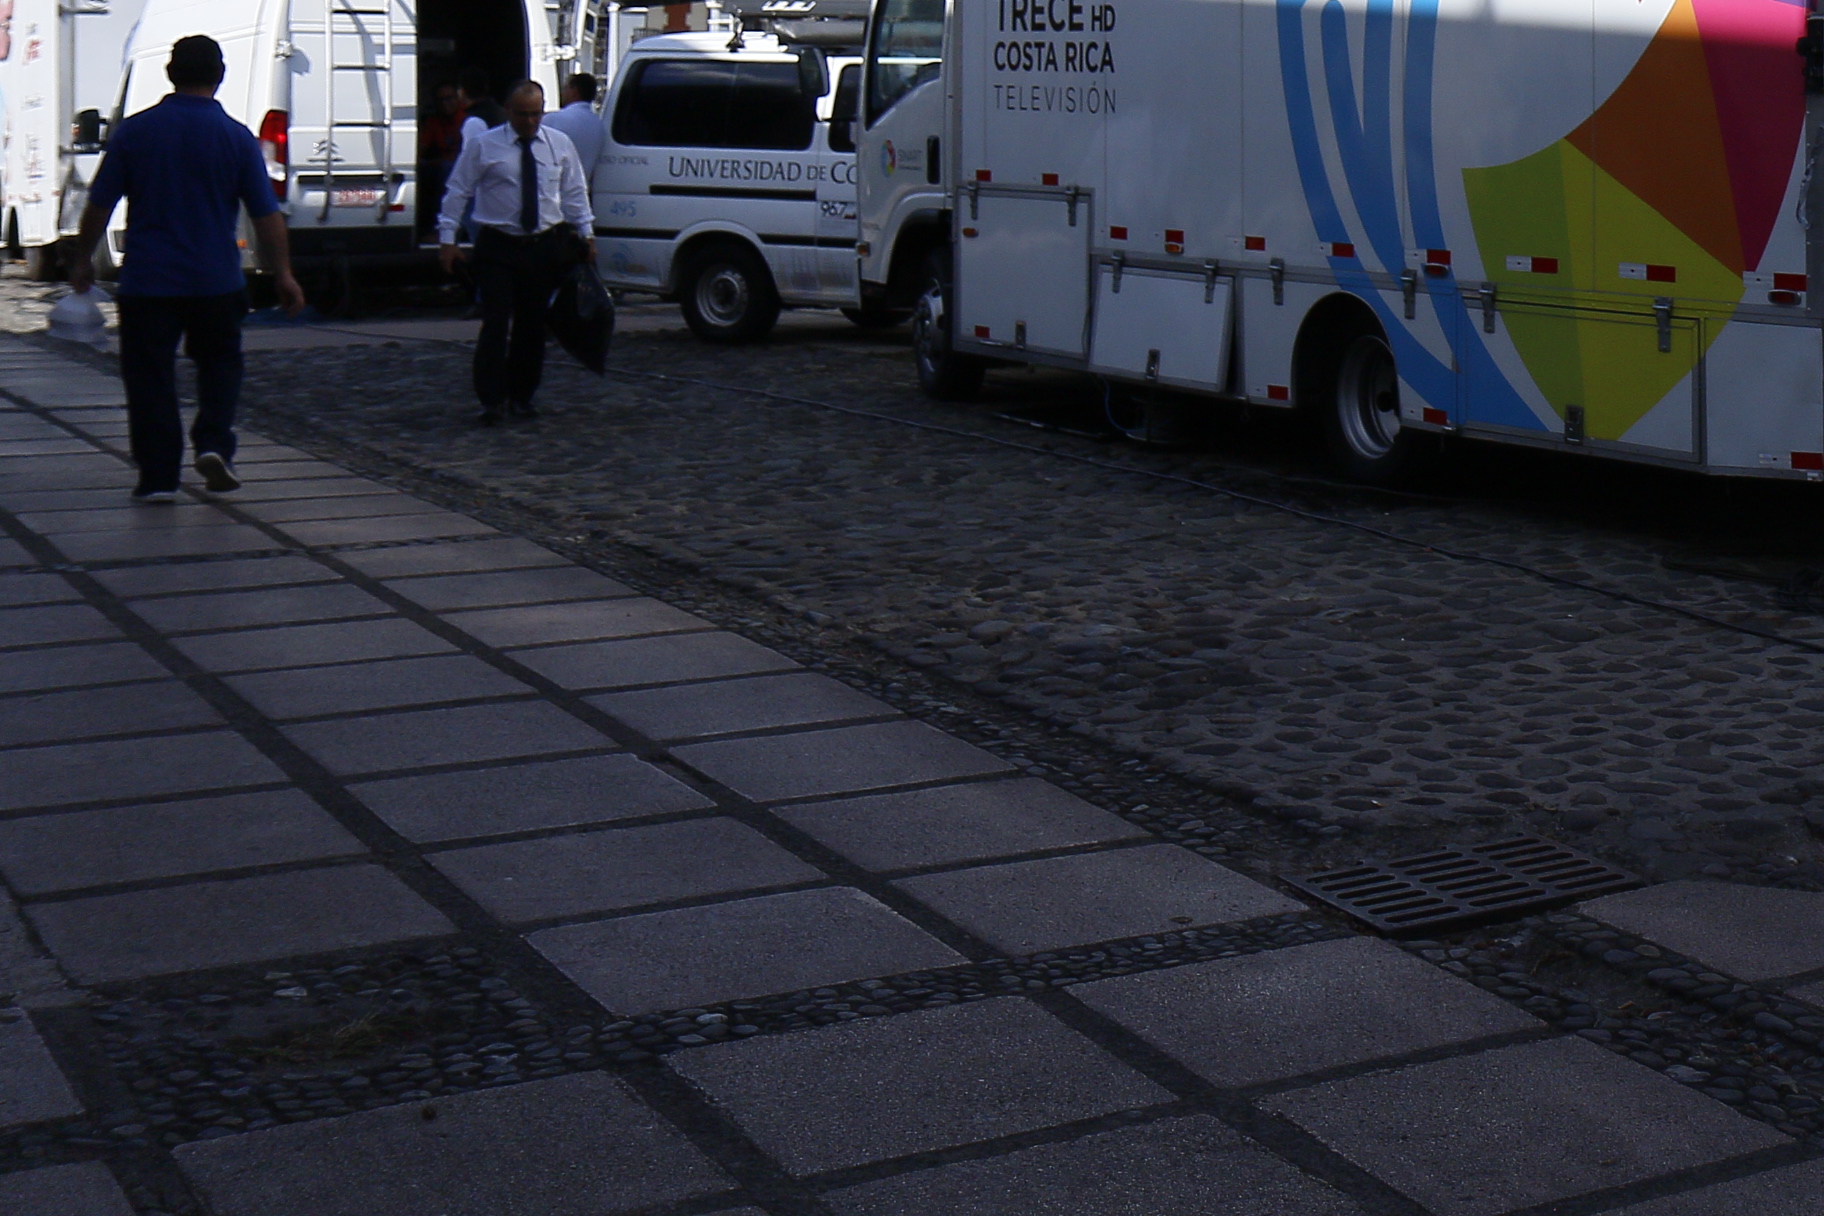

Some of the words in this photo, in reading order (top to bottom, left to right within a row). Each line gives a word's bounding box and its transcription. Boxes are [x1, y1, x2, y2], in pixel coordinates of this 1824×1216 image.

[1091, 4, 1116, 32] HD
[994, 40, 1059, 72] COSTA
[1065, 40, 1115, 73] RICA
[994, 80, 1116, 115] TELEVISIÓN
[668, 155, 801, 182] UNIVERSIDAD
[806, 164, 826, 181] DE
